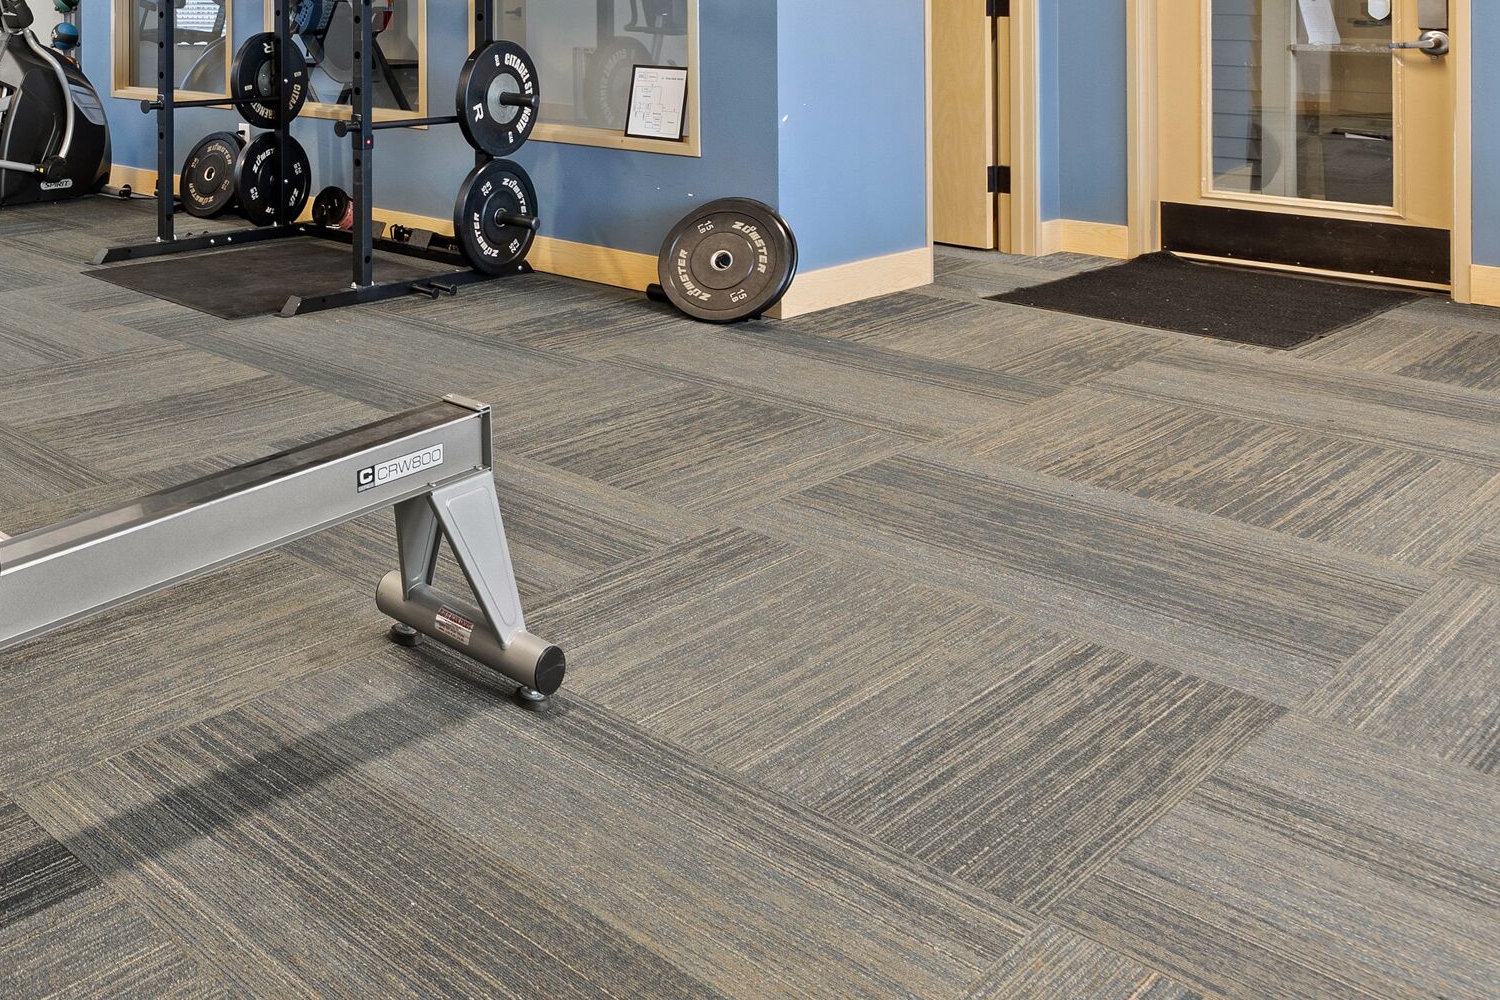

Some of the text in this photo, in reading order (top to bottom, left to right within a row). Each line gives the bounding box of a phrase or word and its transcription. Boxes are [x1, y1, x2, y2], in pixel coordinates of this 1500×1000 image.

[504, 52, 533, 134] CITADEL STNGTH
[697, 223, 706, 234] LB
[705, 220, 714, 231] 15
[729, 292, 739, 302] LB
[737, 288, 748, 300] 15
[359, 448, 441, 485] C CRW800
